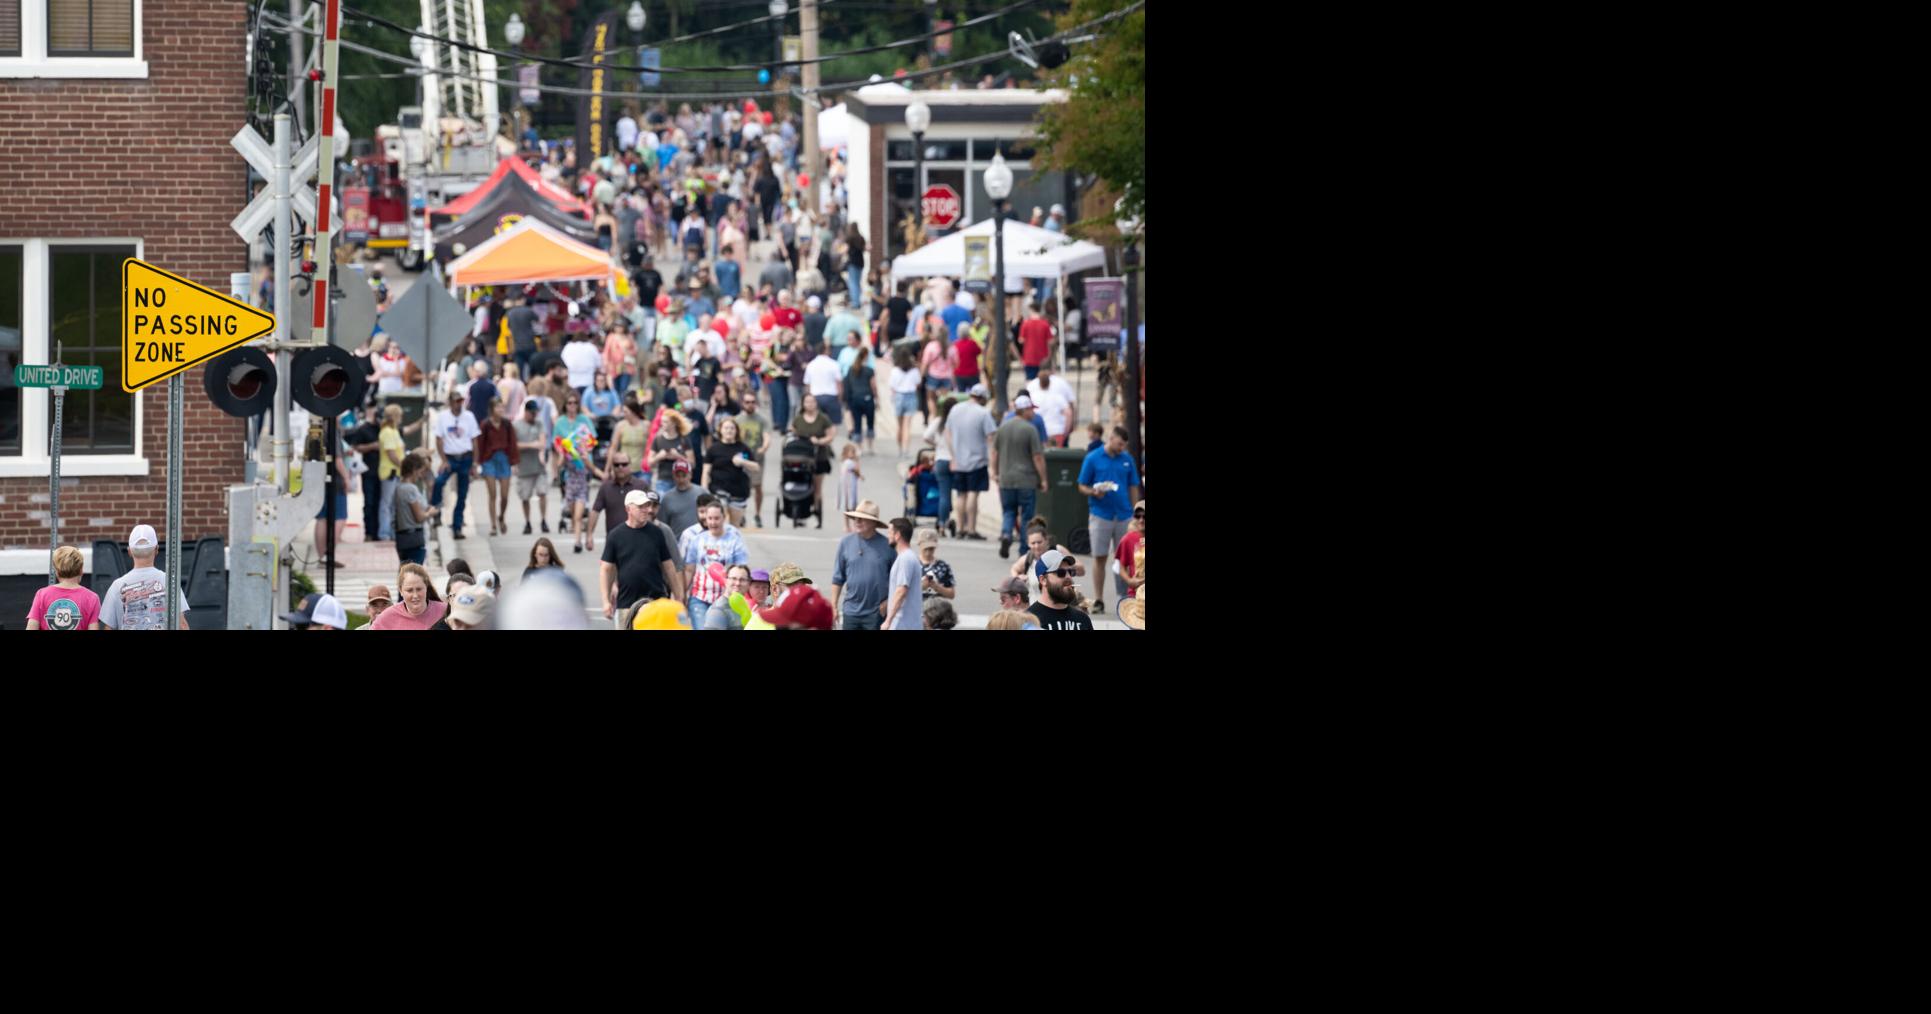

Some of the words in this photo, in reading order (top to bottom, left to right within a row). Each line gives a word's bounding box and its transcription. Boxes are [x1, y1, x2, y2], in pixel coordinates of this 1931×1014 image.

[921, 197, 957, 217] STOP
[135, 287, 166, 308] NO
[134, 314, 238, 336] PASSING
[134, 341, 186, 363] ZONE
[19, 366, 61, 385] UNITED
[64, 367, 99, 386] DRIVE
[57, 612, 69, 623] 90
